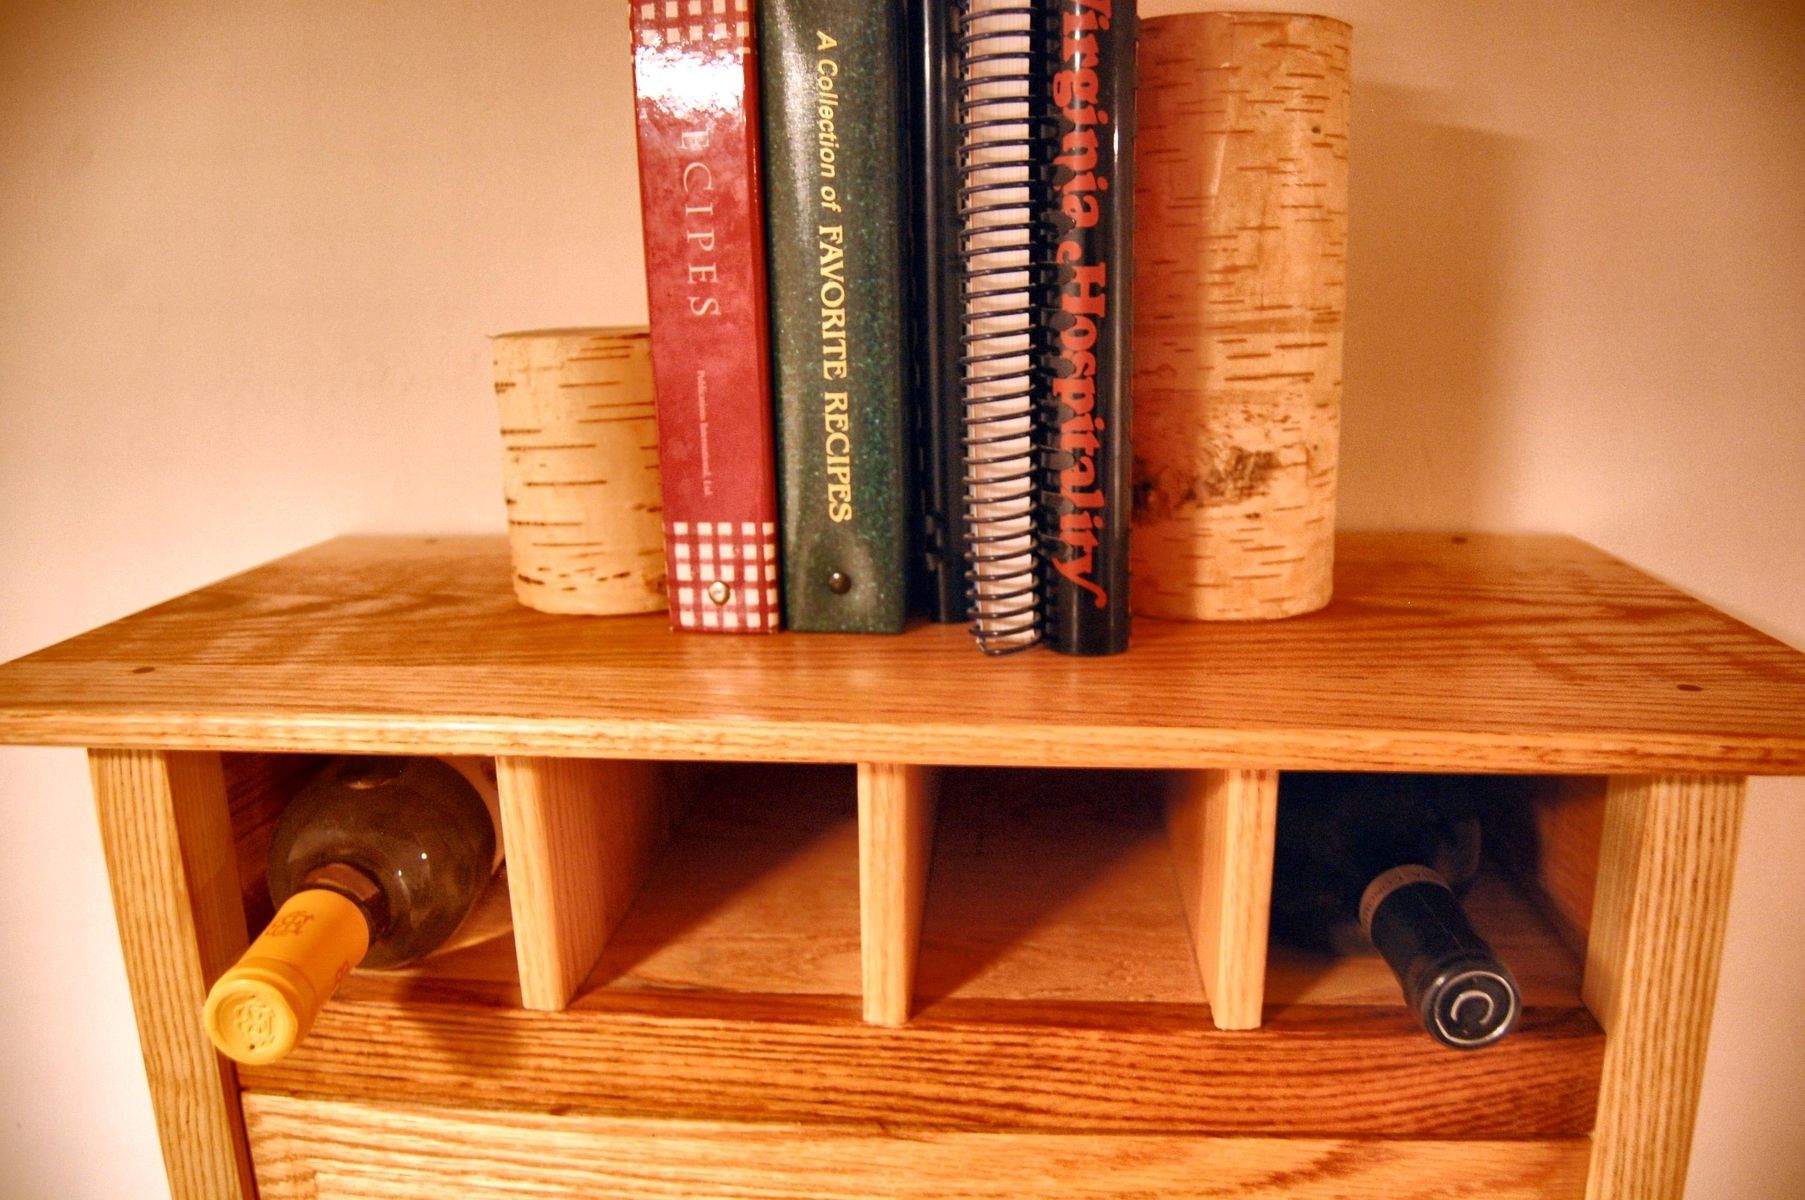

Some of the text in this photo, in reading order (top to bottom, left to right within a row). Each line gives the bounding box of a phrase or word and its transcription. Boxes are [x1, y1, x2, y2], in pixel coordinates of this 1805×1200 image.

[680, 100, 720, 316] ECIPES
[816, 30, 852, 523] A Collection of FAVORITE RECIPES
[1052, 239, 1107, 609] Hospitality
